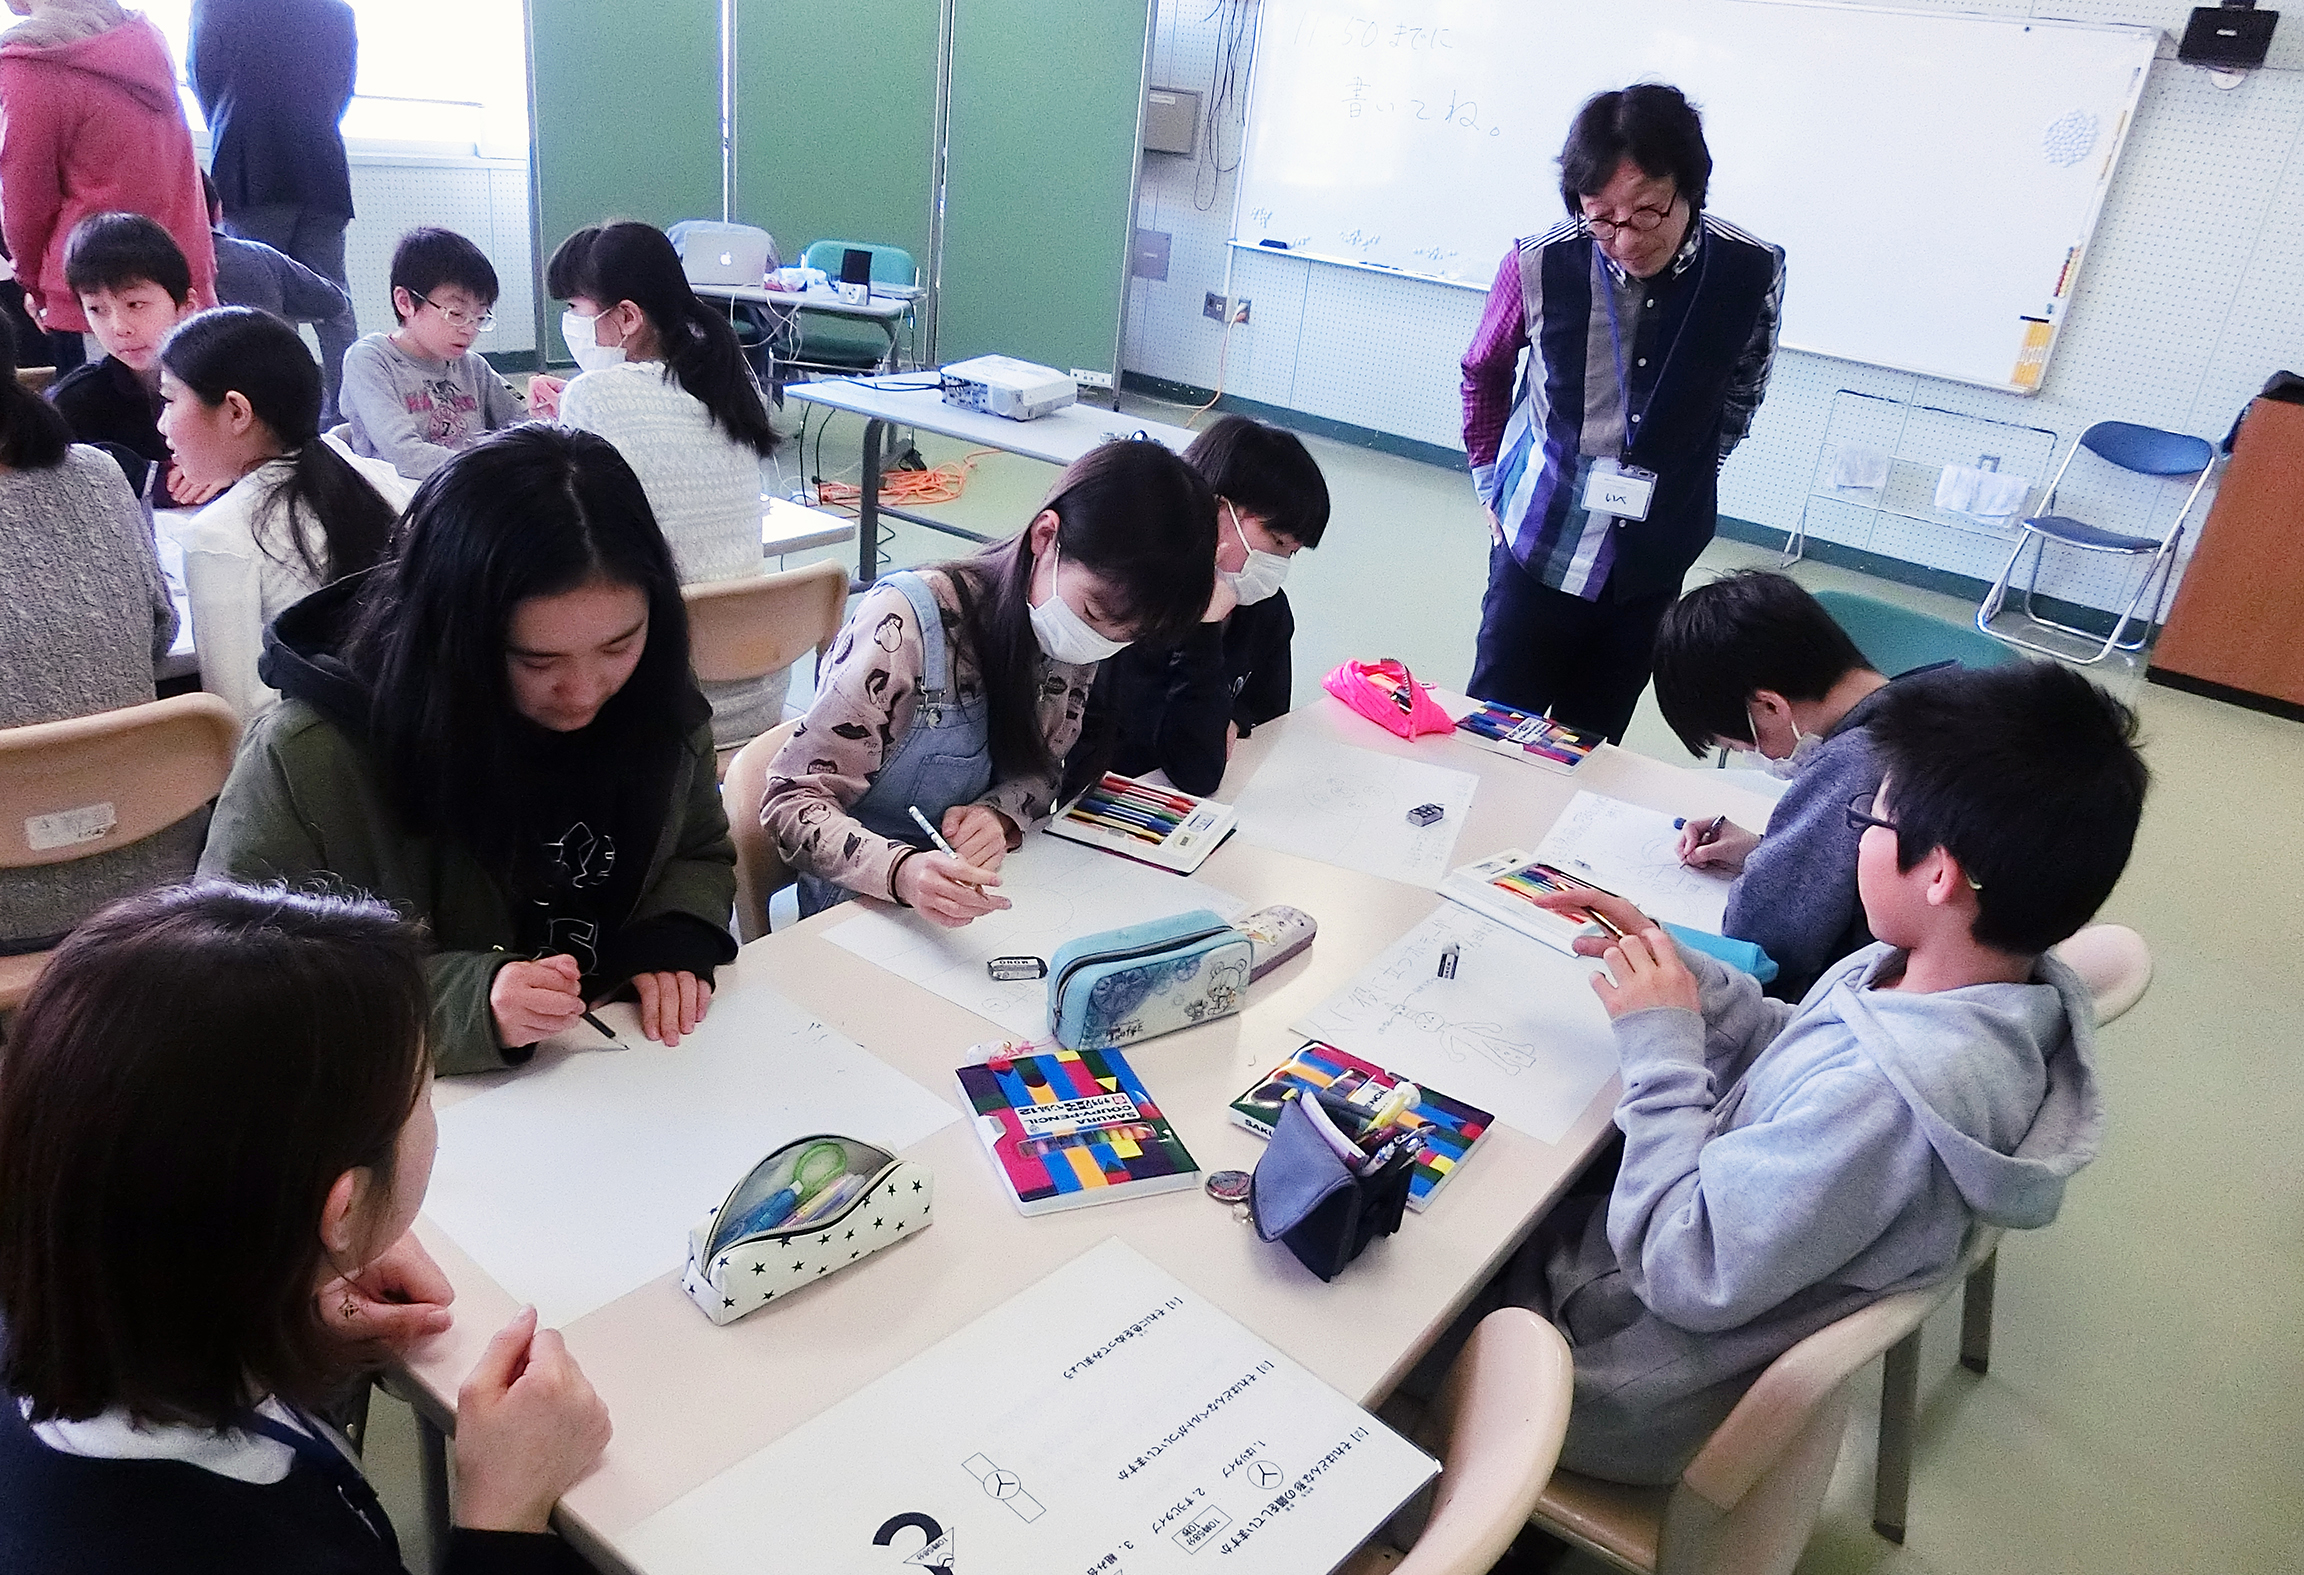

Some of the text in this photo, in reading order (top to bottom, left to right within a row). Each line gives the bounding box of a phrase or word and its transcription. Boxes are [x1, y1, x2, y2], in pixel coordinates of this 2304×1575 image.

[1341, 75, 1500, 138] 書いてね。
[1076, 1111, 1137, 1125] SAKURA
